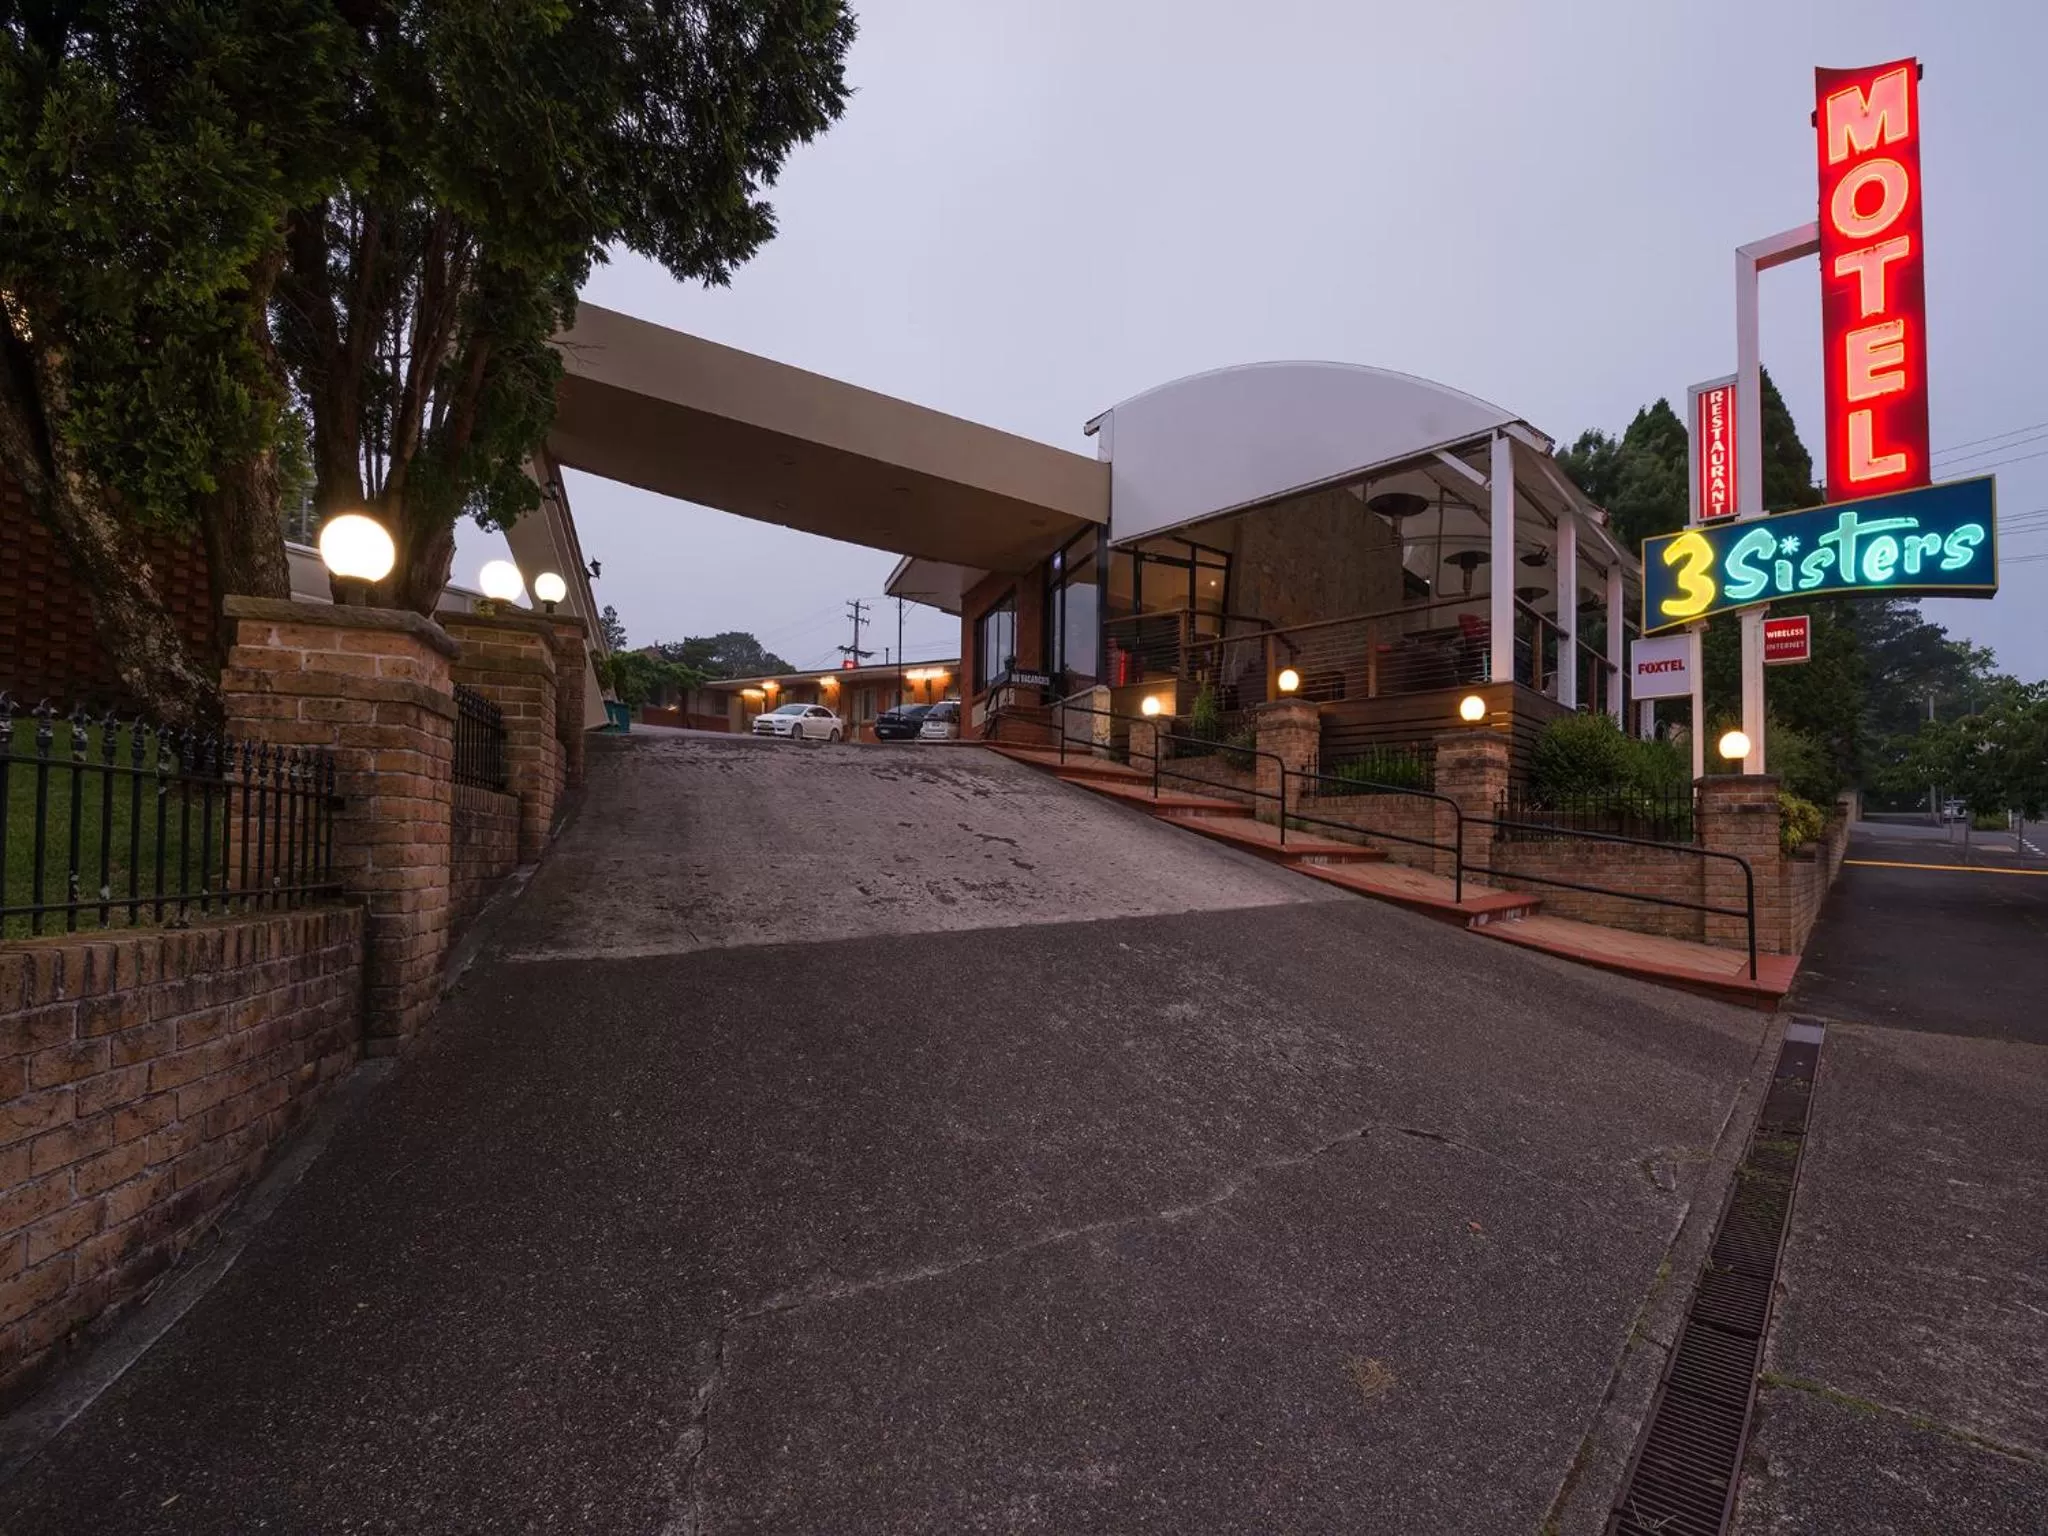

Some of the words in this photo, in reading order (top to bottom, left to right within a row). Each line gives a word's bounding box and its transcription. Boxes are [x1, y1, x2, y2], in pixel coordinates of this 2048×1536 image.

[1826, 67, 1910, 483] MOTEL
[1710, 390, 1725, 515] RESTAURANT
[1661, 530, 1716, 617] 3
[1724, 511, 1985, 599] Sisters
[1766, 627, 1805, 639] WIRELESS
[1766, 640, 1805, 651] INTERNET
[1638, 658, 1685, 675] FOXTEL
